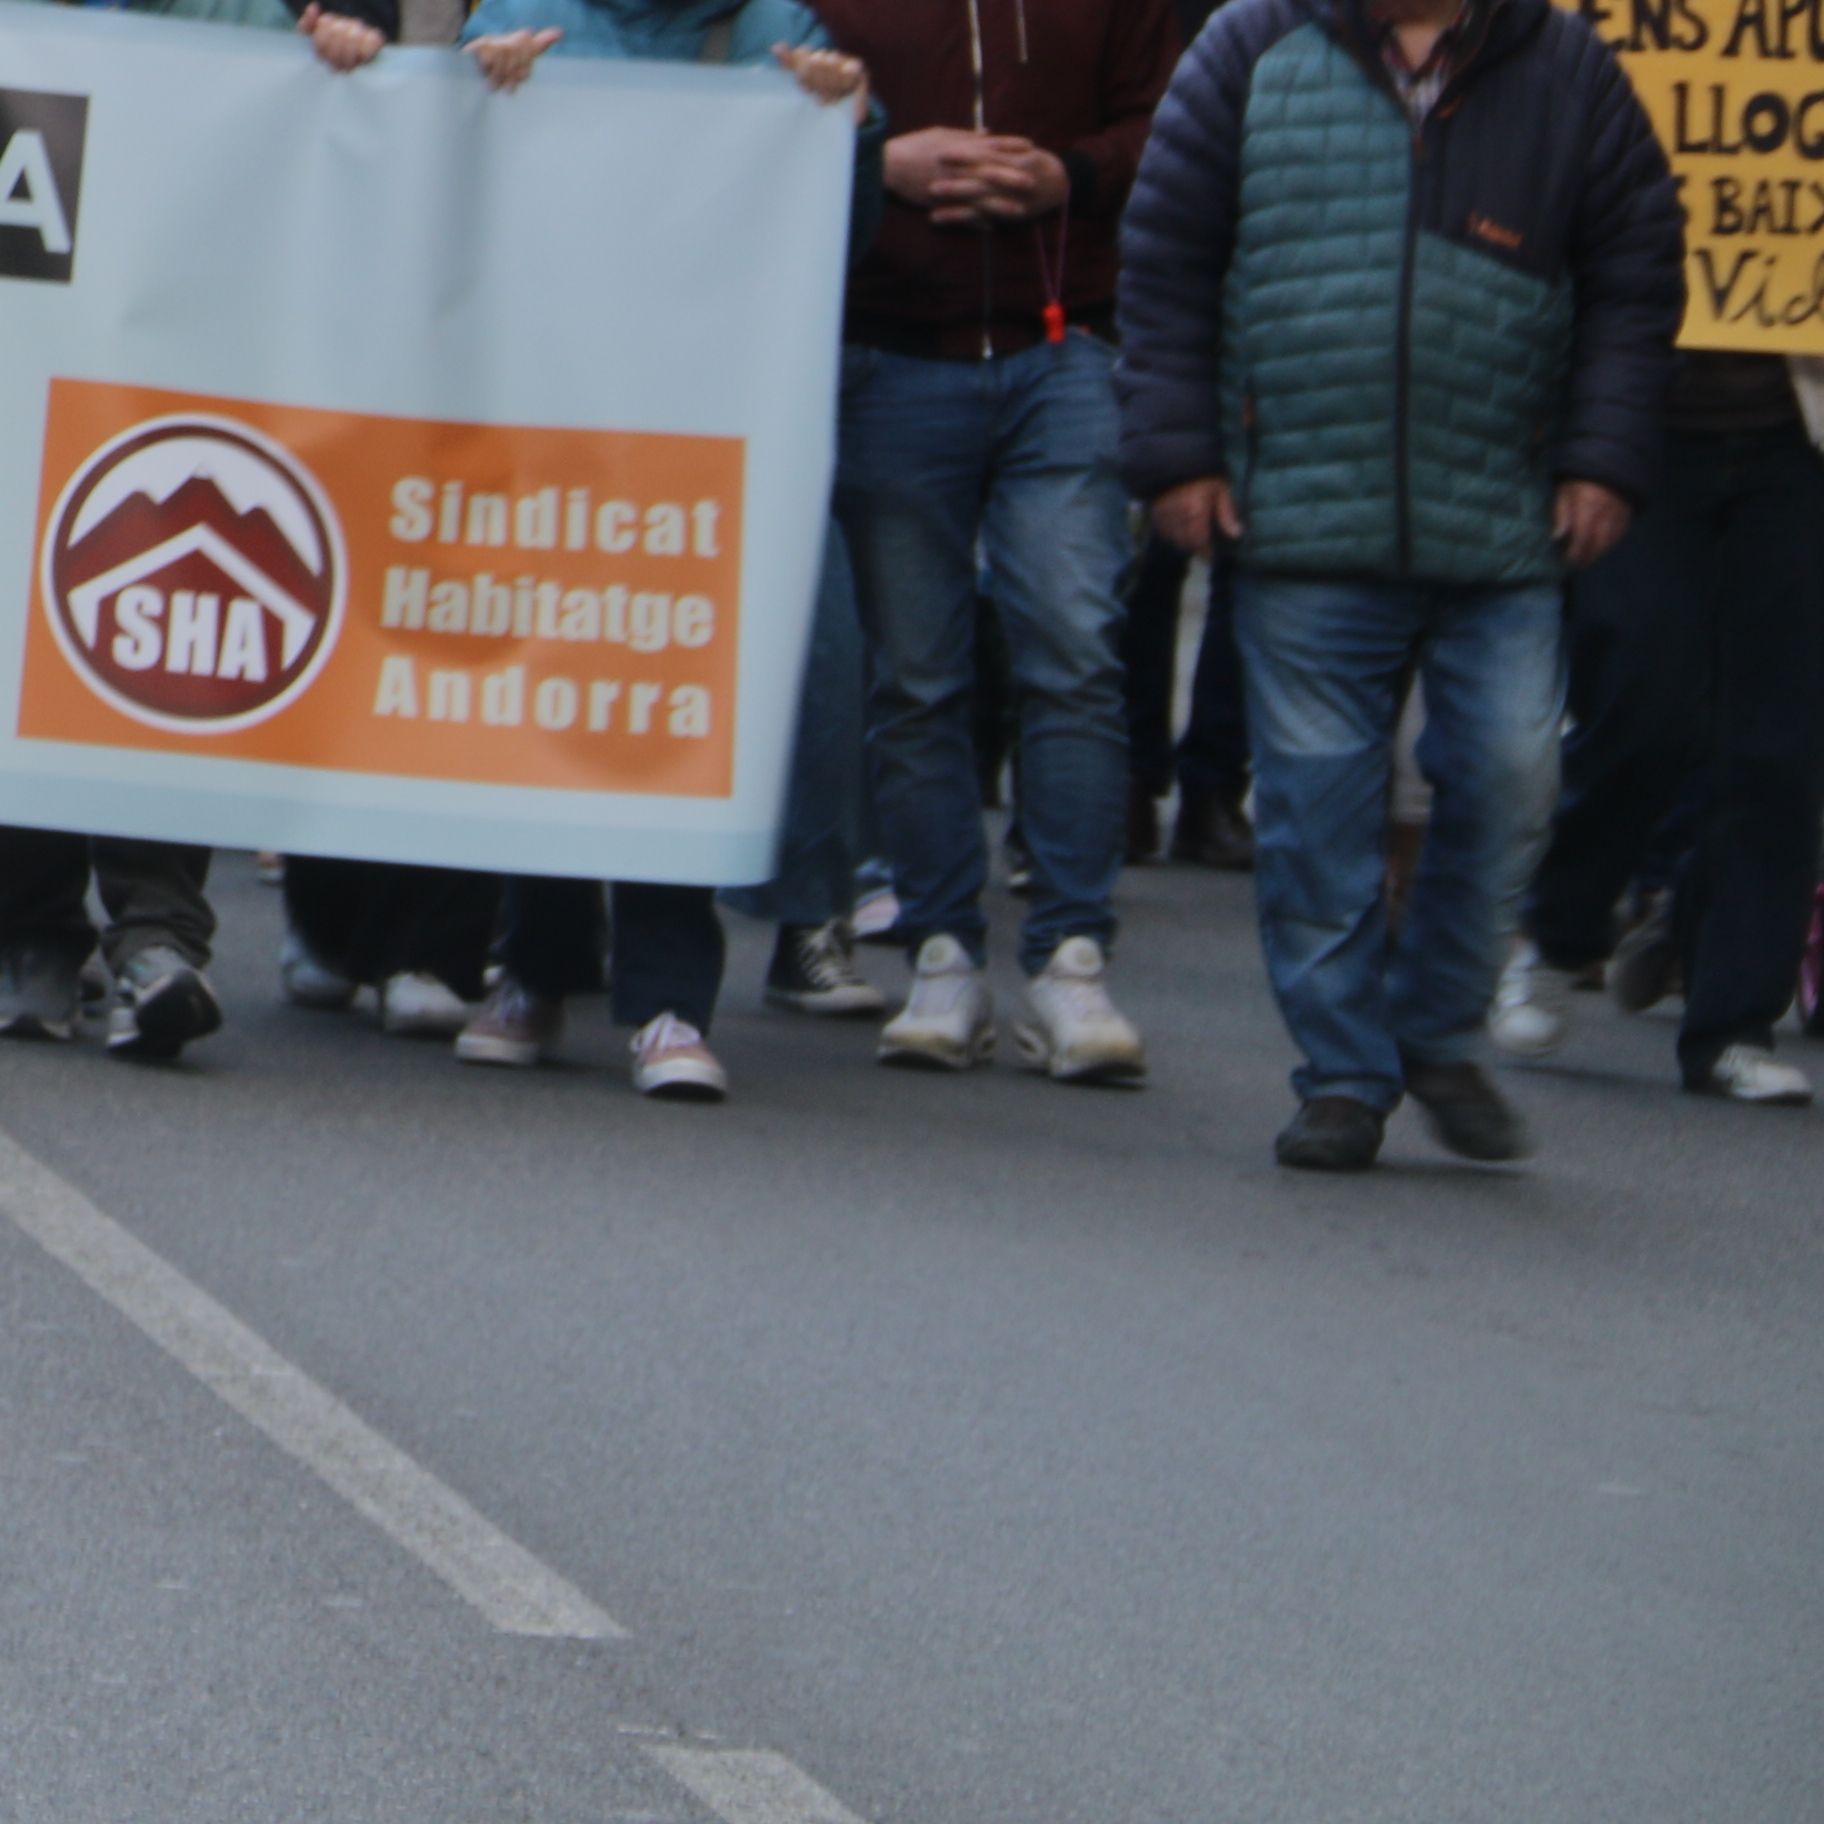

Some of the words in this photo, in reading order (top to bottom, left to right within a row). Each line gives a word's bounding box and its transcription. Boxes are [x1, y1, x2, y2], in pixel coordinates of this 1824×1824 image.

[389, 475, 721, 559] Sindicat
[112, 584, 268, 683] SHA
[380, 565, 716, 654] Habitatge
[372, 656, 713, 739] Andorra
